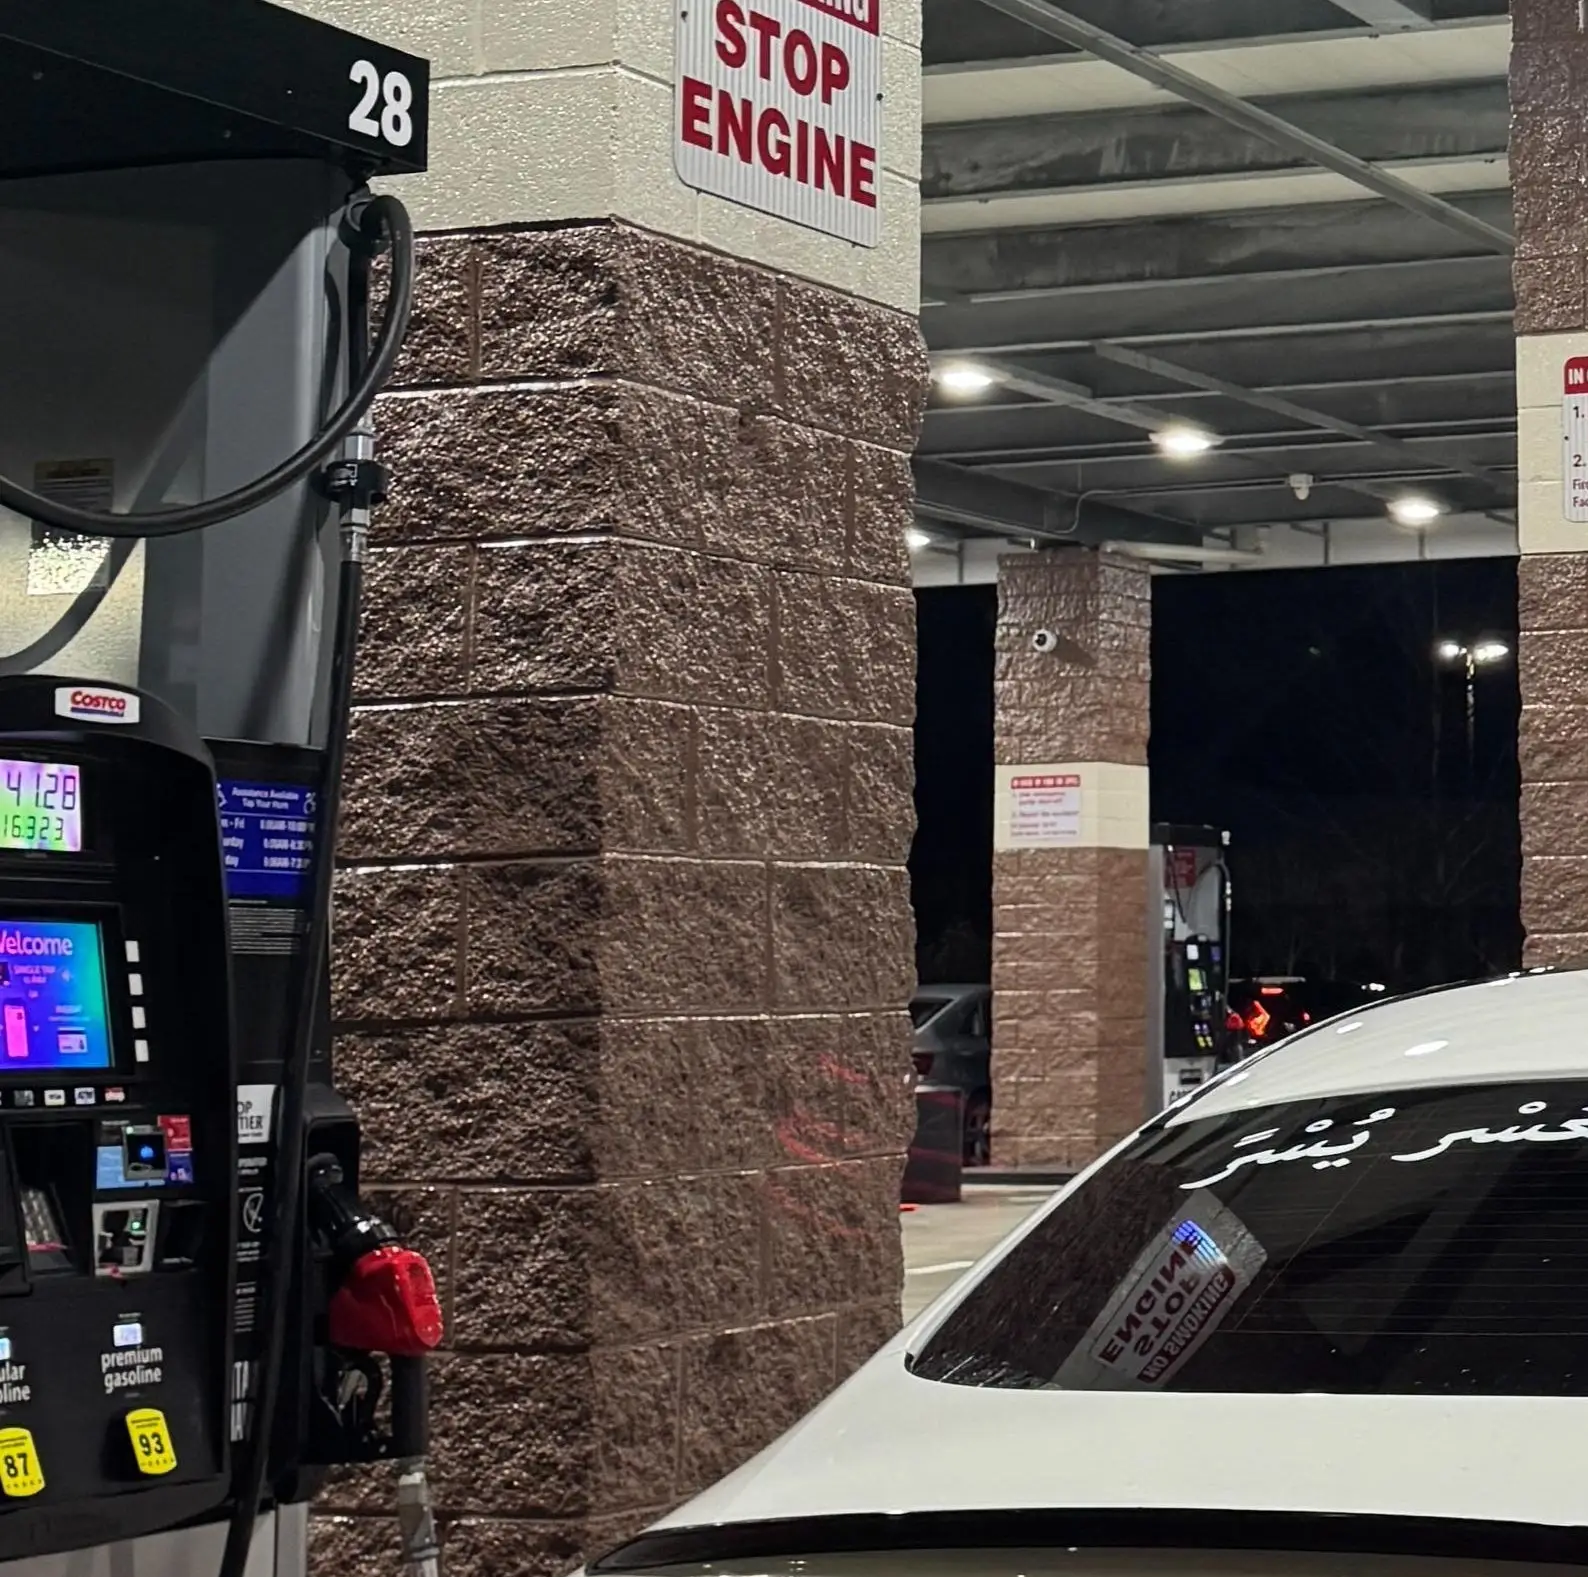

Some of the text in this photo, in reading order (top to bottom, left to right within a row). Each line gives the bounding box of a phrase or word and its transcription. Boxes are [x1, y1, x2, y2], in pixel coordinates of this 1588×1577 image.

[714, 0, 850, 106] STOP
[348, 59, 413, 147] 28
[681, 75, 877, 209] ENGINE
[1568, 367, 1584, 385] IN
[1573, 406, 1585, 419] 1.
[1573, 454, 1586, 467] 2.
[70, 691, 126, 710] COSTCO
[101, 1346, 163, 1374] premium
[104, 1365, 162, 1394] gasoline
[138, 1432, 165, 1457] 93
[4, 1452, 30, 1479] 87
